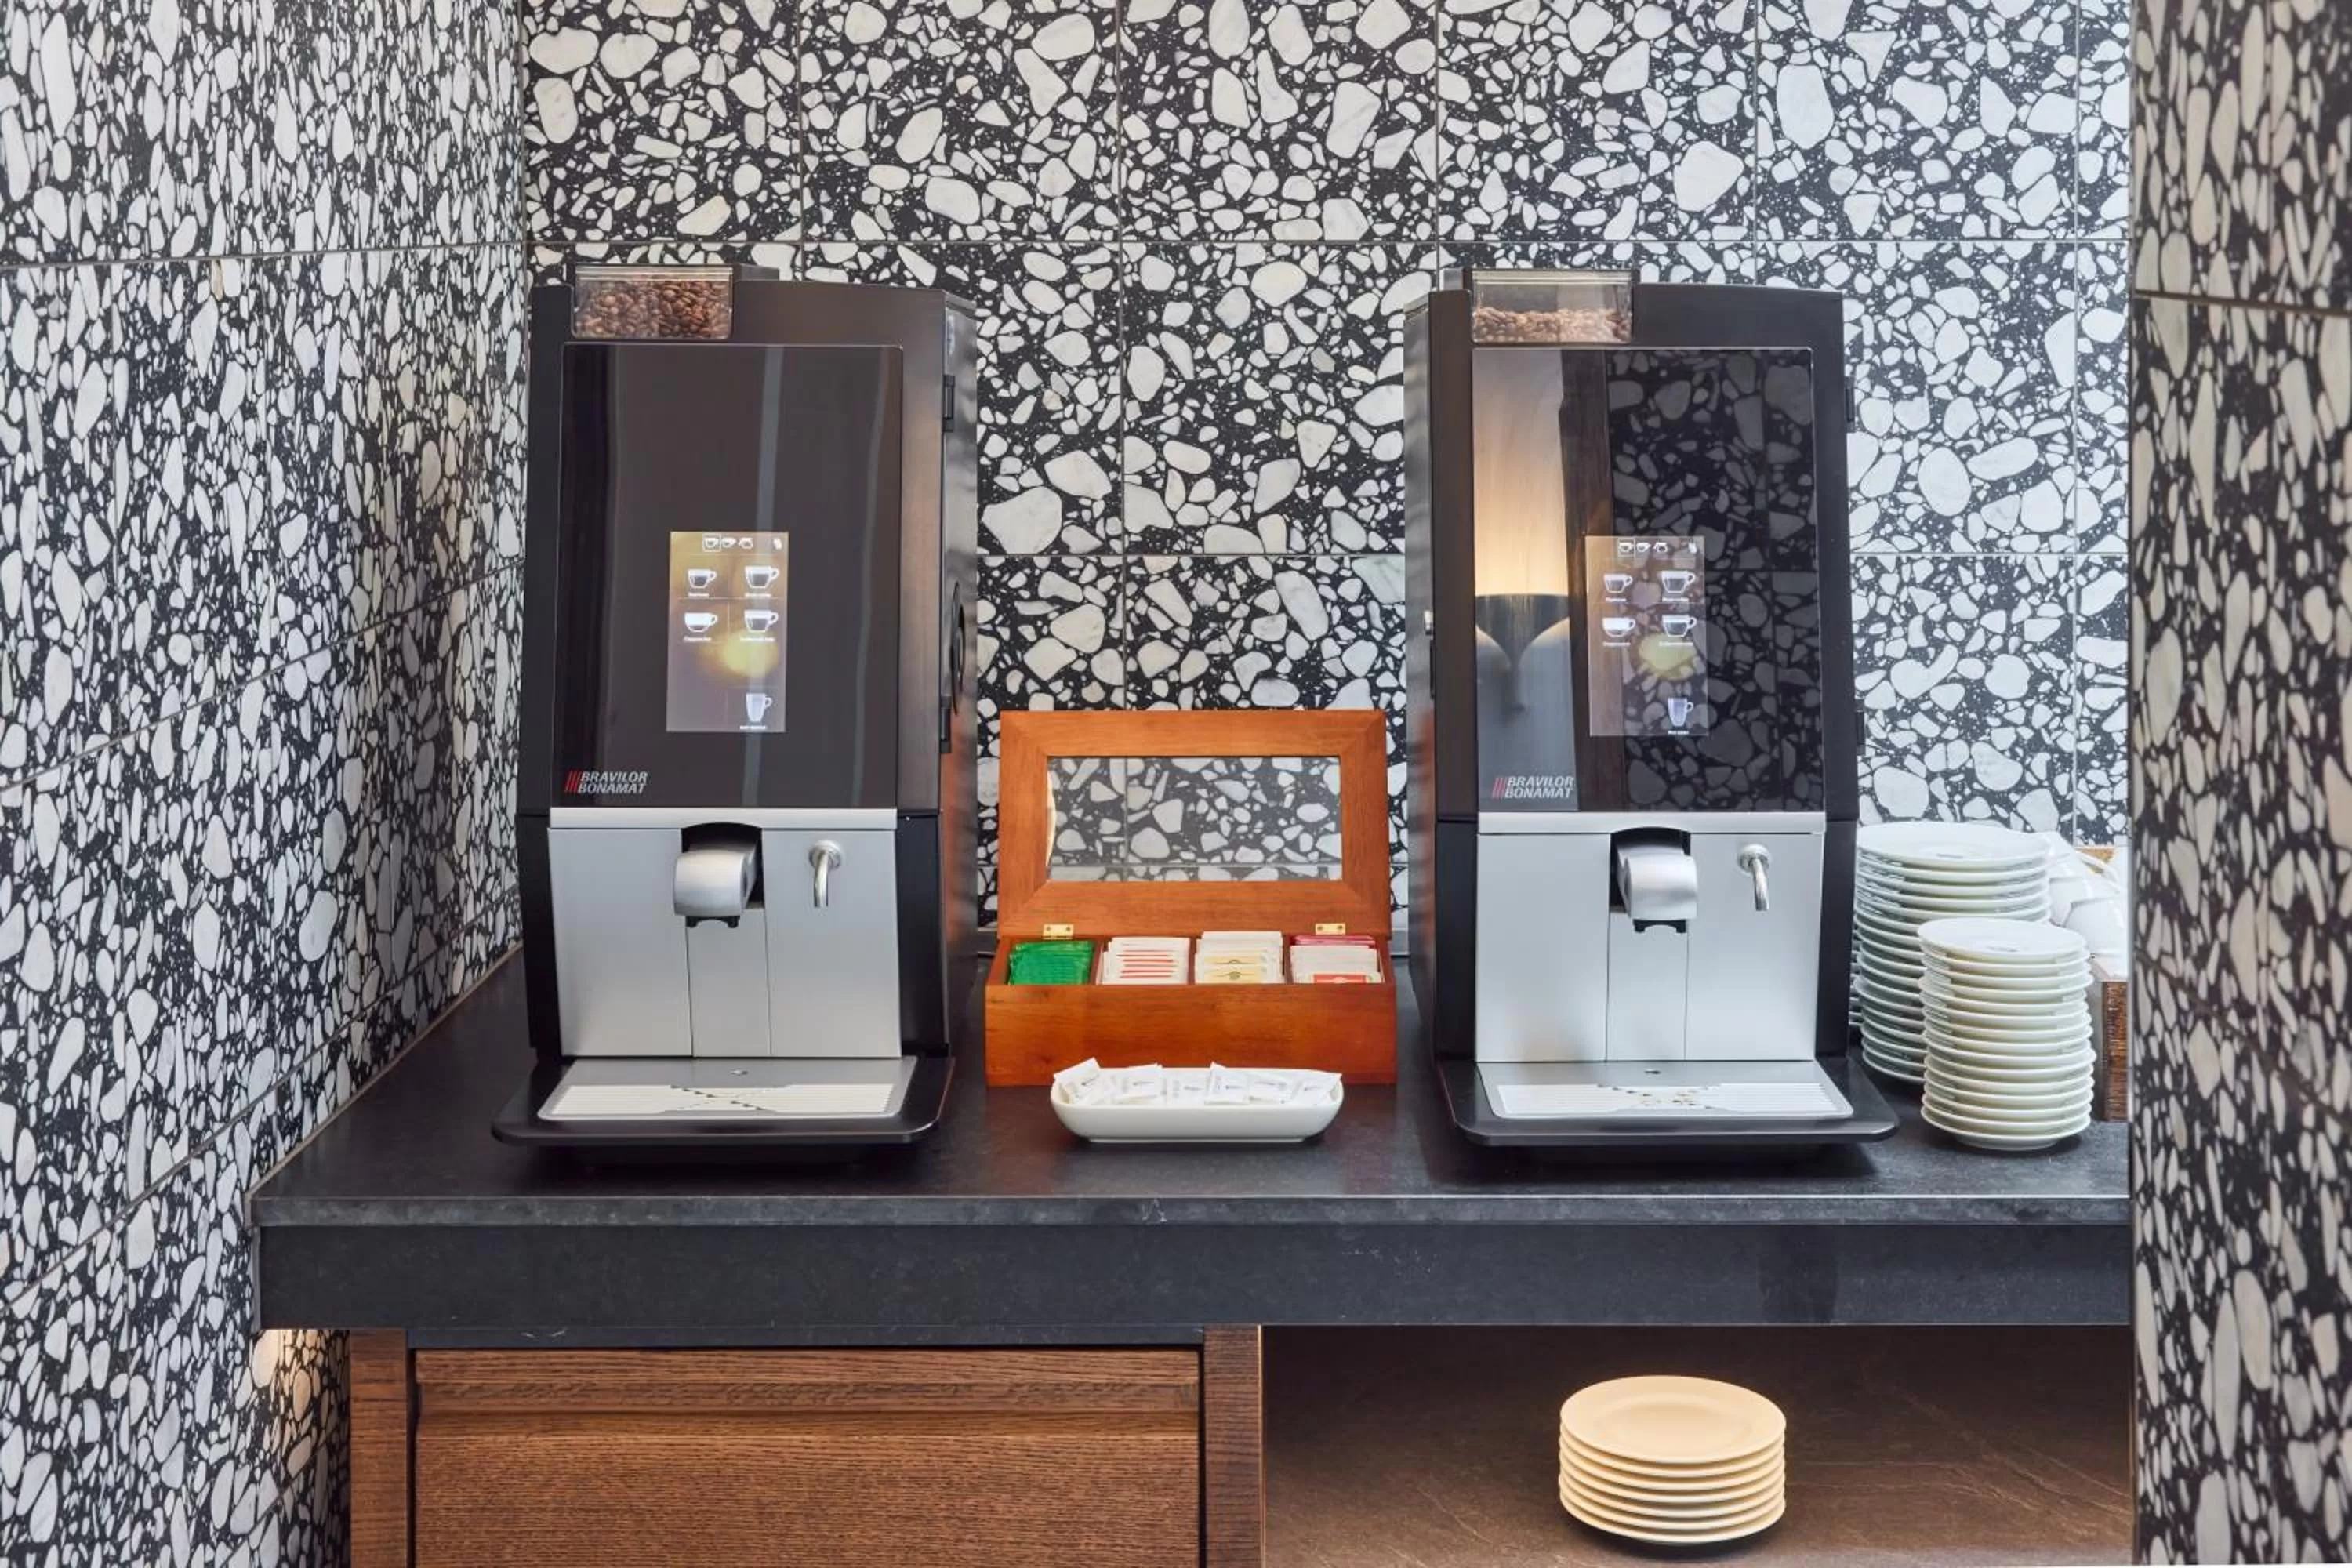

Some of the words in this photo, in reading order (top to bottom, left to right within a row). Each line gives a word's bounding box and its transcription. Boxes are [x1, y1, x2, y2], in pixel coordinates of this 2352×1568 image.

[581, 771, 648, 782] BRAVILOR
[1507, 775, 1575, 786] BRAVILOR
[578, 783, 646, 794] BONAMAT
[1504, 787, 1573, 799] BONAMAT
